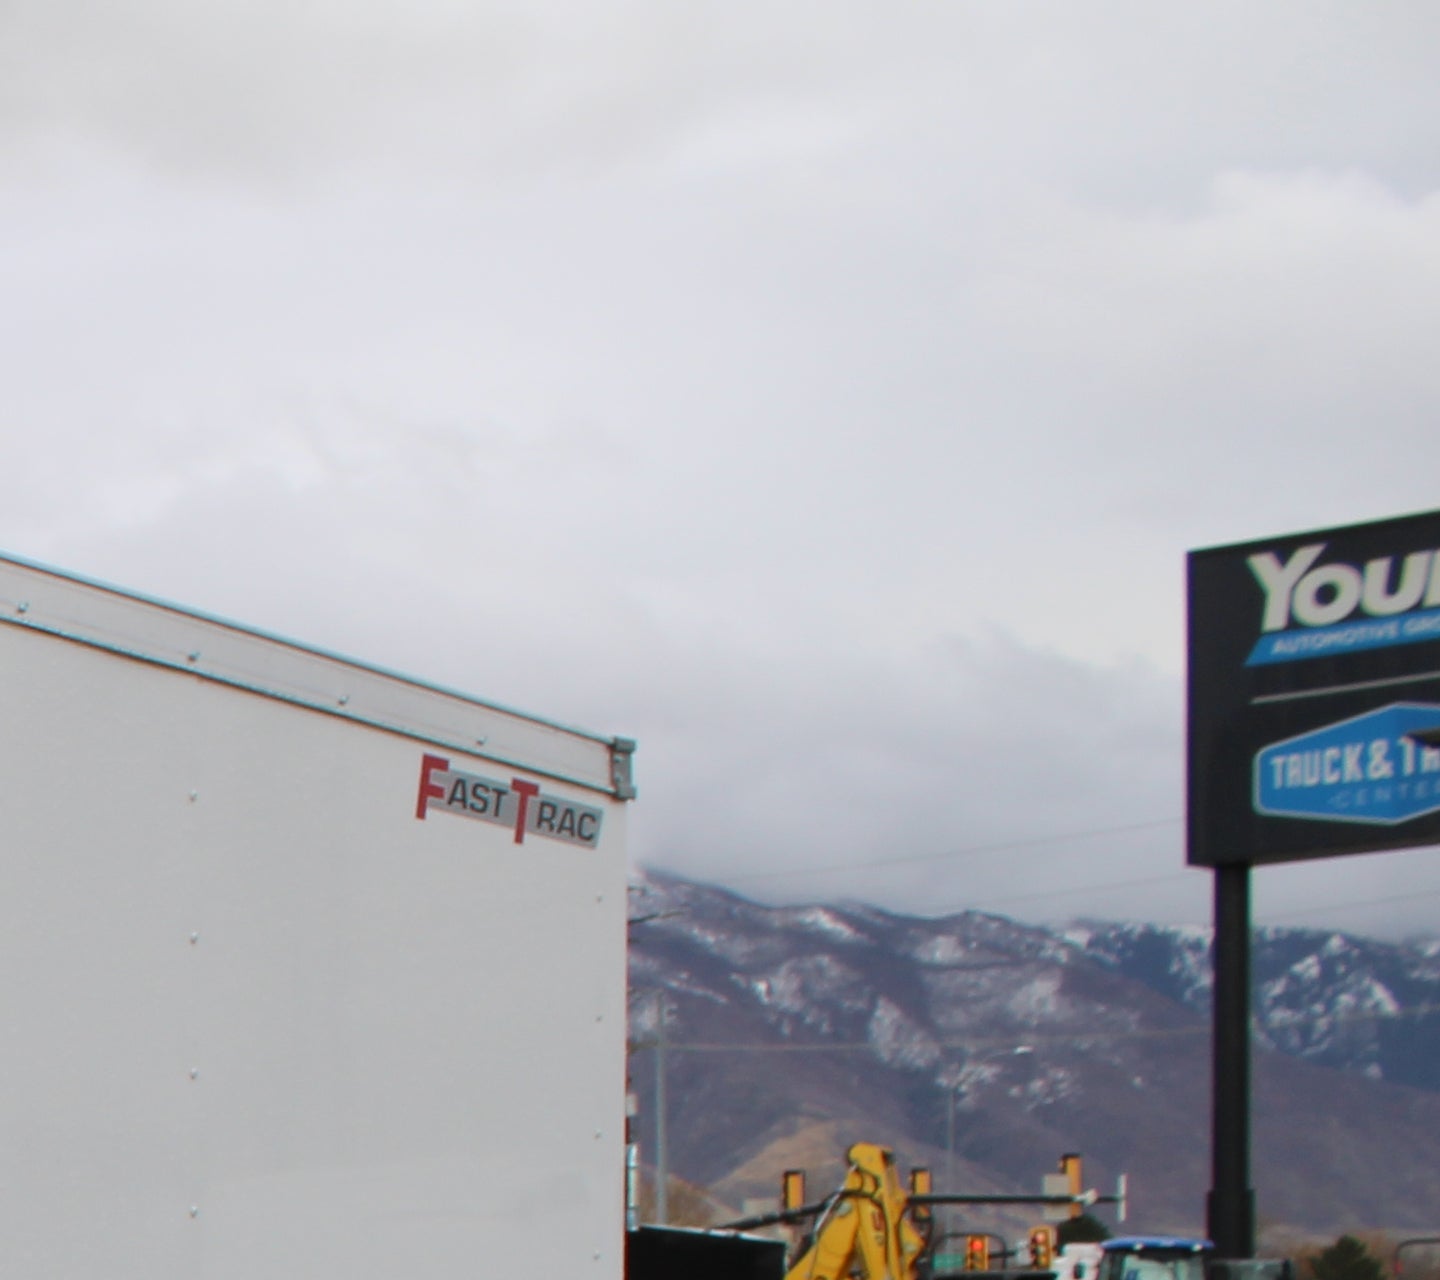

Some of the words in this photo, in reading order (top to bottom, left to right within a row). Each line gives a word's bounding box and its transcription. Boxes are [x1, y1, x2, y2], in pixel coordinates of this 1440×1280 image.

[1246, 542, 1440, 634] YOU
[1269, 619, 1399, 656] AUTOMOTIVE
[415, 752, 508, 820] FAST
[510, 777, 597, 844] TRAC
[1270, 742, 1364, 790] TRUCK
[1366, 738, 1394, 780] &
